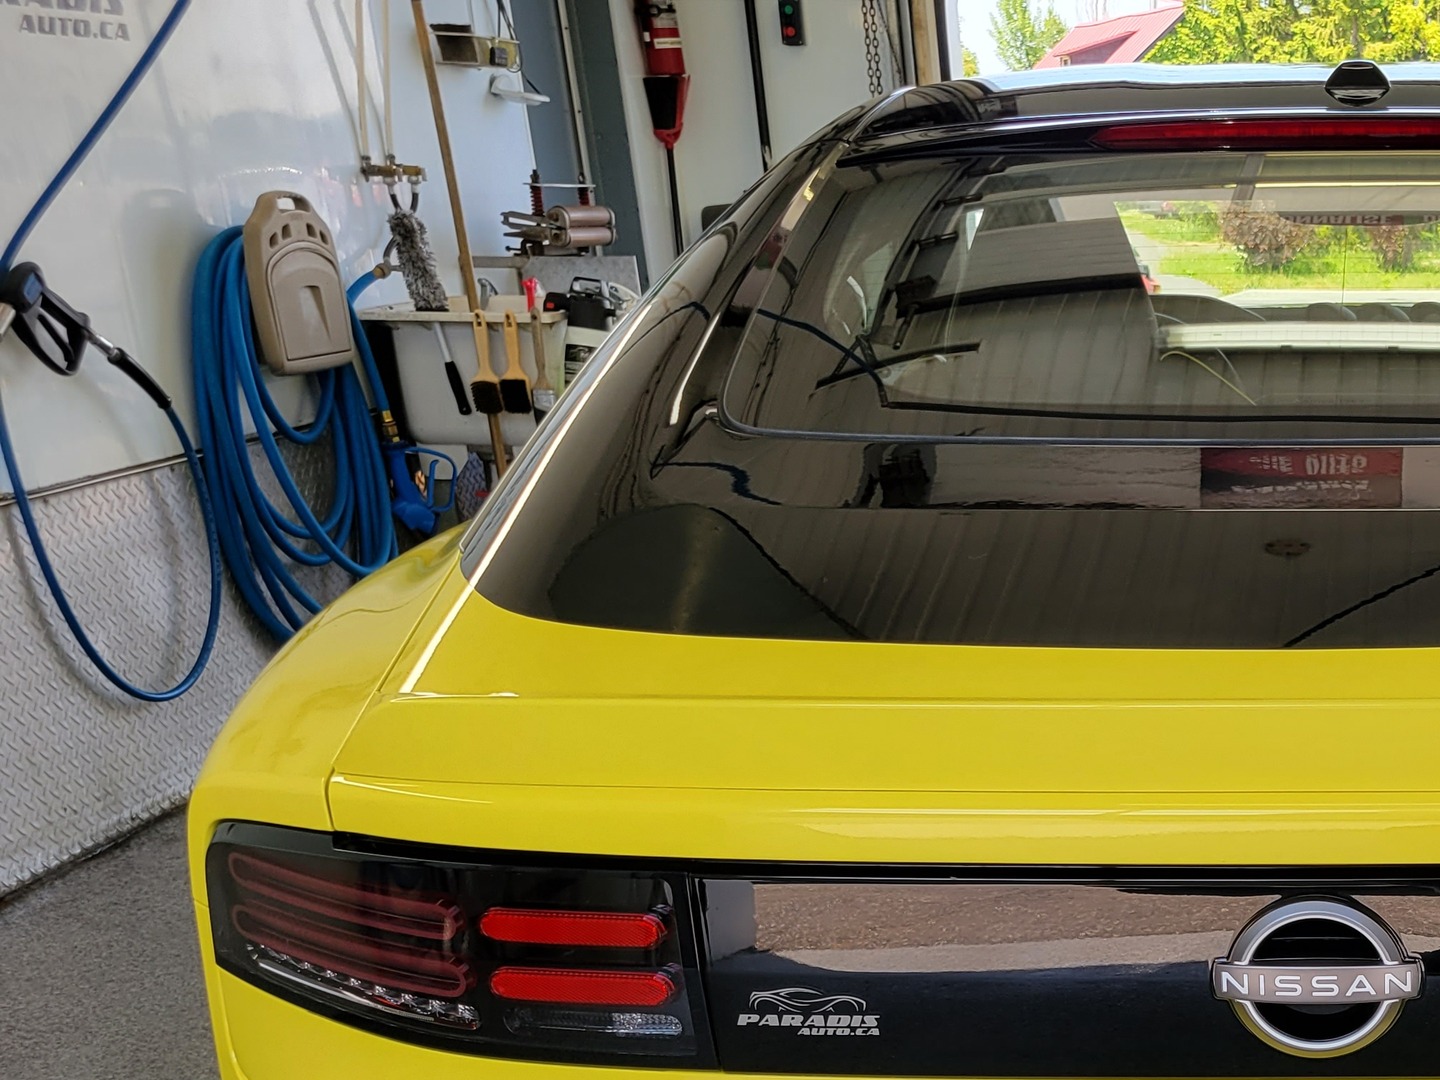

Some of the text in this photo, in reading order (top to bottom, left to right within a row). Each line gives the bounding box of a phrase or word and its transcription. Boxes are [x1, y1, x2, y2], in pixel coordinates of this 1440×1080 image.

[20, 14, 131, 41] AUTO.CA
[1221, 971, 1412, 997] NISSAN
[737, 1014, 880, 1027] PARADIS
[797, 1028, 880, 1036] AUTO.CA
